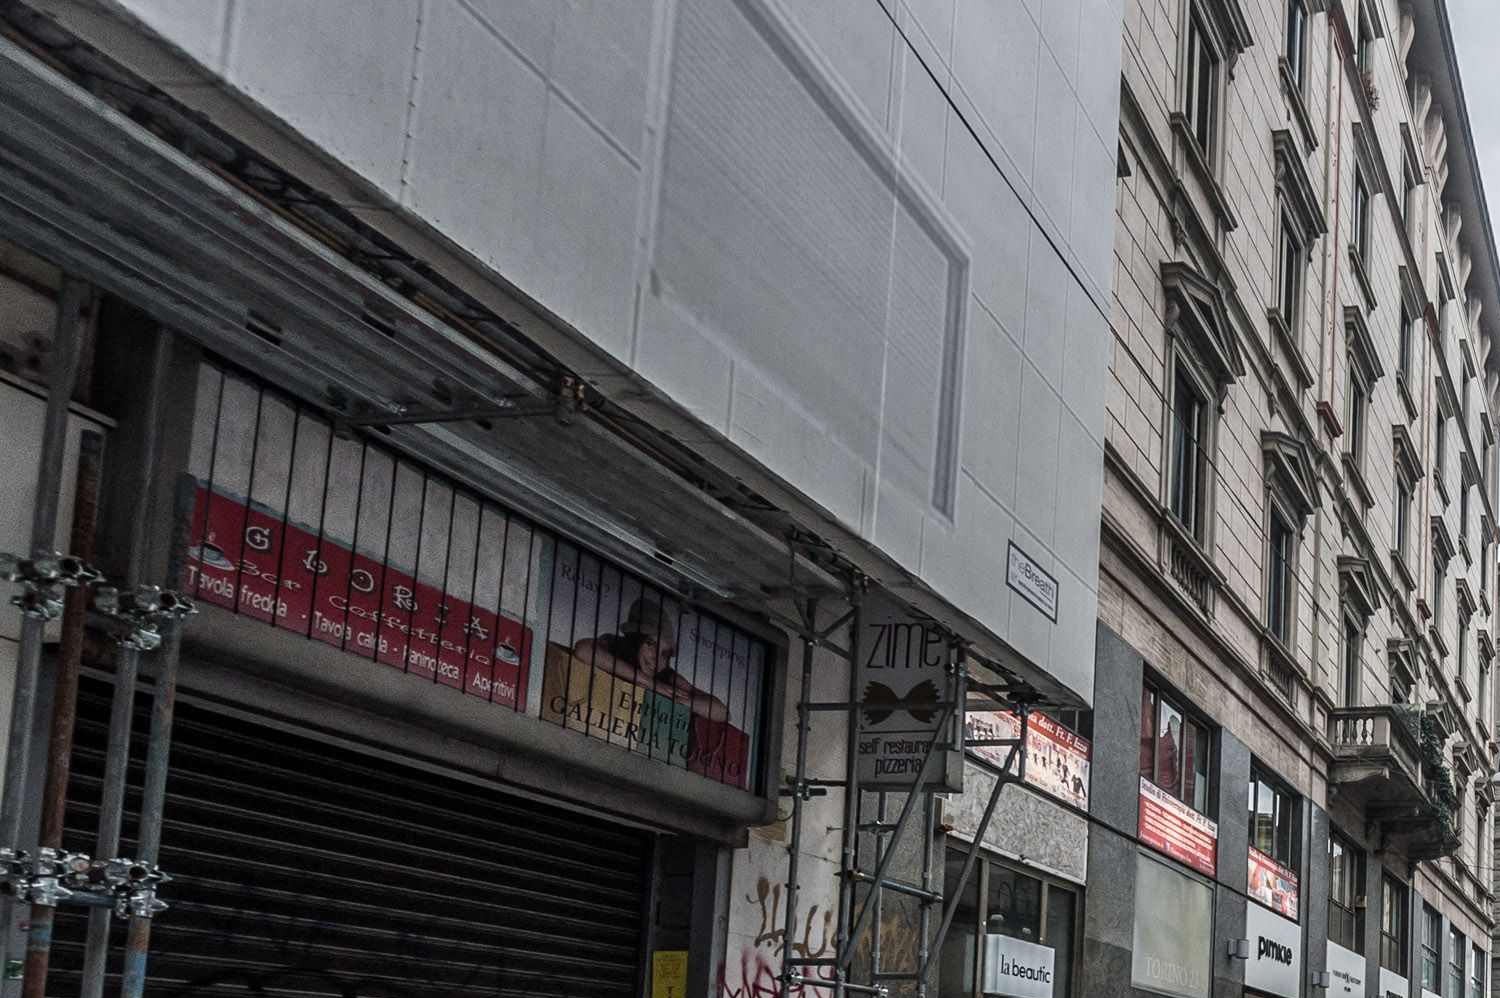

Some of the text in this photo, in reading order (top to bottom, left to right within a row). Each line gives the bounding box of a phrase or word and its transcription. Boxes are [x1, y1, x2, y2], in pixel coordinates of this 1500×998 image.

[187, 565, 234, 598] Tavola
[550, 695, 741, 778] GALLERIA TORINO
[859, 737, 934, 755] self restaura
[874, 755, 922, 778] pizzeria
[1257, 936, 1293, 966] pimkie
[1000, 953, 1051, 984] la beautic
